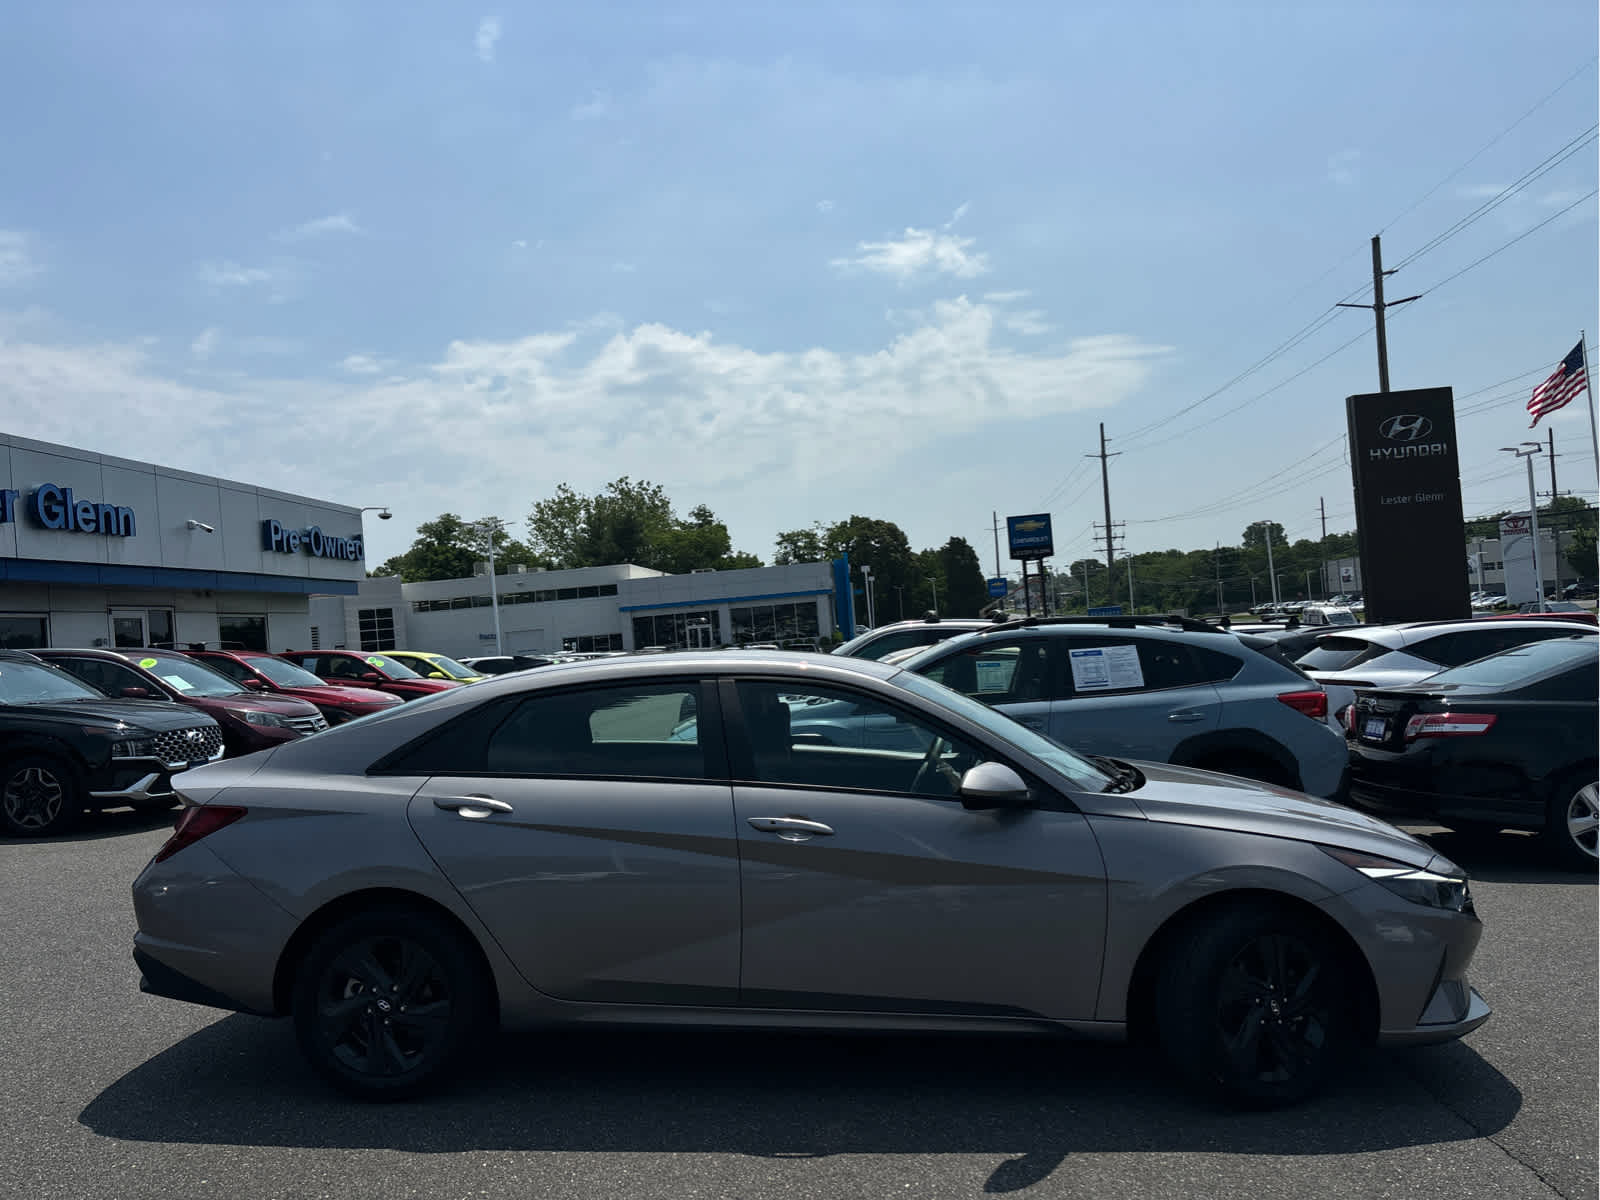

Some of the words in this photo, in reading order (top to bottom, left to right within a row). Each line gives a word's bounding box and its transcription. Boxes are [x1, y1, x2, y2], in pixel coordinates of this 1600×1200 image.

[1370, 443, 1447, 461] HYUNDAI
[0, 488, 20, 523] r
[35, 483, 136, 537] Glenn
[1380, 494, 1411, 505] Lester
[1415, 490, 1445, 504] Glenn
[264, 519, 365, 561] Pre-Owned
